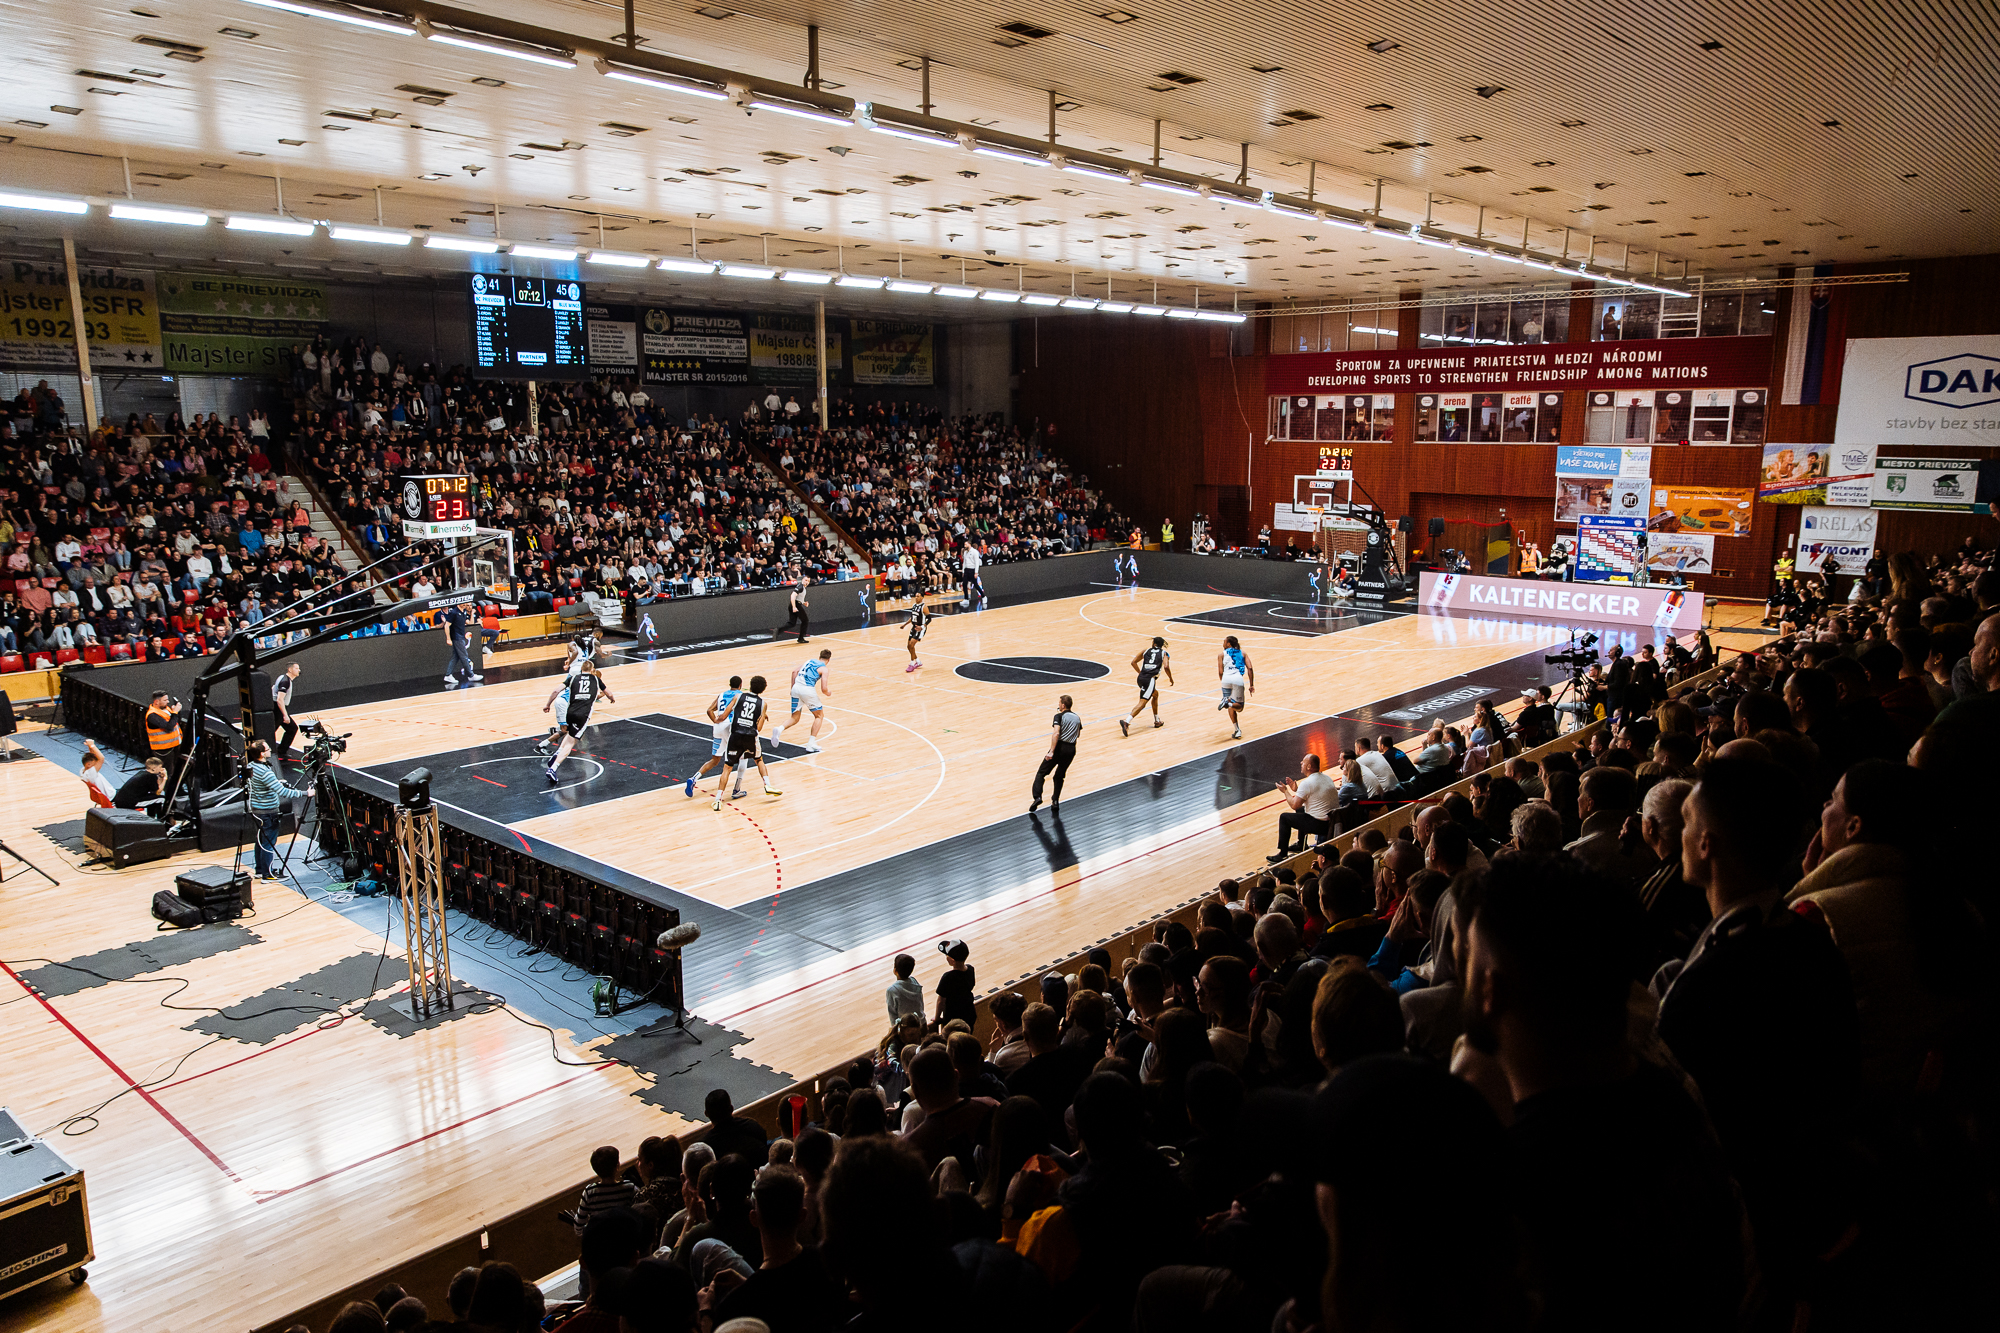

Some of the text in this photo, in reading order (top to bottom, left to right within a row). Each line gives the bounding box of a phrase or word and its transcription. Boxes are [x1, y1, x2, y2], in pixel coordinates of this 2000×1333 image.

[192, 281, 322, 299] BC PRIEVIDZA
[488, 279, 499, 291] 41
[526, 281, 531, 289] 3
[556, 285, 567, 295] 45
[518, 290, 541, 302] 07:12
[547, 301, 551, 309] 2
[673, 316, 742, 328] PRIEVIDZA
[857, 320, 872, 333] BC
[757, 334, 800, 350] Majster
[169, 342, 290, 368] Majster SR
[1335, 347, 1662, 371] ŠPORTOM ZA UPEVNENIE PRIATEĽSTVA MEDZI NÁRODMI
[606, 366, 635, 375] POHÁRA
[1308, 366, 1708, 386] DEVELOPING SPORTS TO STRENGTHEN FRIENDSHIP AMONG NATIONS
[646, 372, 747, 382] MAJSTER SR 2015/2016
[1443, 397, 1466, 406] arena
[1510, 394, 1532, 405] caffé
[1886, 417, 1936, 431] stavby
[1941, 417, 1968, 429] bez
[1321, 459, 1336, 469] 23
[1341, 459, 1351, 469] 23
[1560, 456, 1582, 468] VAŠE
[1842, 454, 1868, 462] TIMES
[1882, 460, 1972, 469] MESTO PRIEVIDZA
[426, 478, 467, 494] 07 12
[436, 500, 463, 519] 23
[1819, 516, 1873, 532] RELAS
[1358, 580, 1385, 588] PARTNERS
[1469, 583, 1640, 617] KALTENECKER
[579, 680, 590, 693] 12
[720, 699, 727, 711] 2
[1408, 687, 1491, 714] PRIEVIDZA
[741, 701, 756, 719] 32
